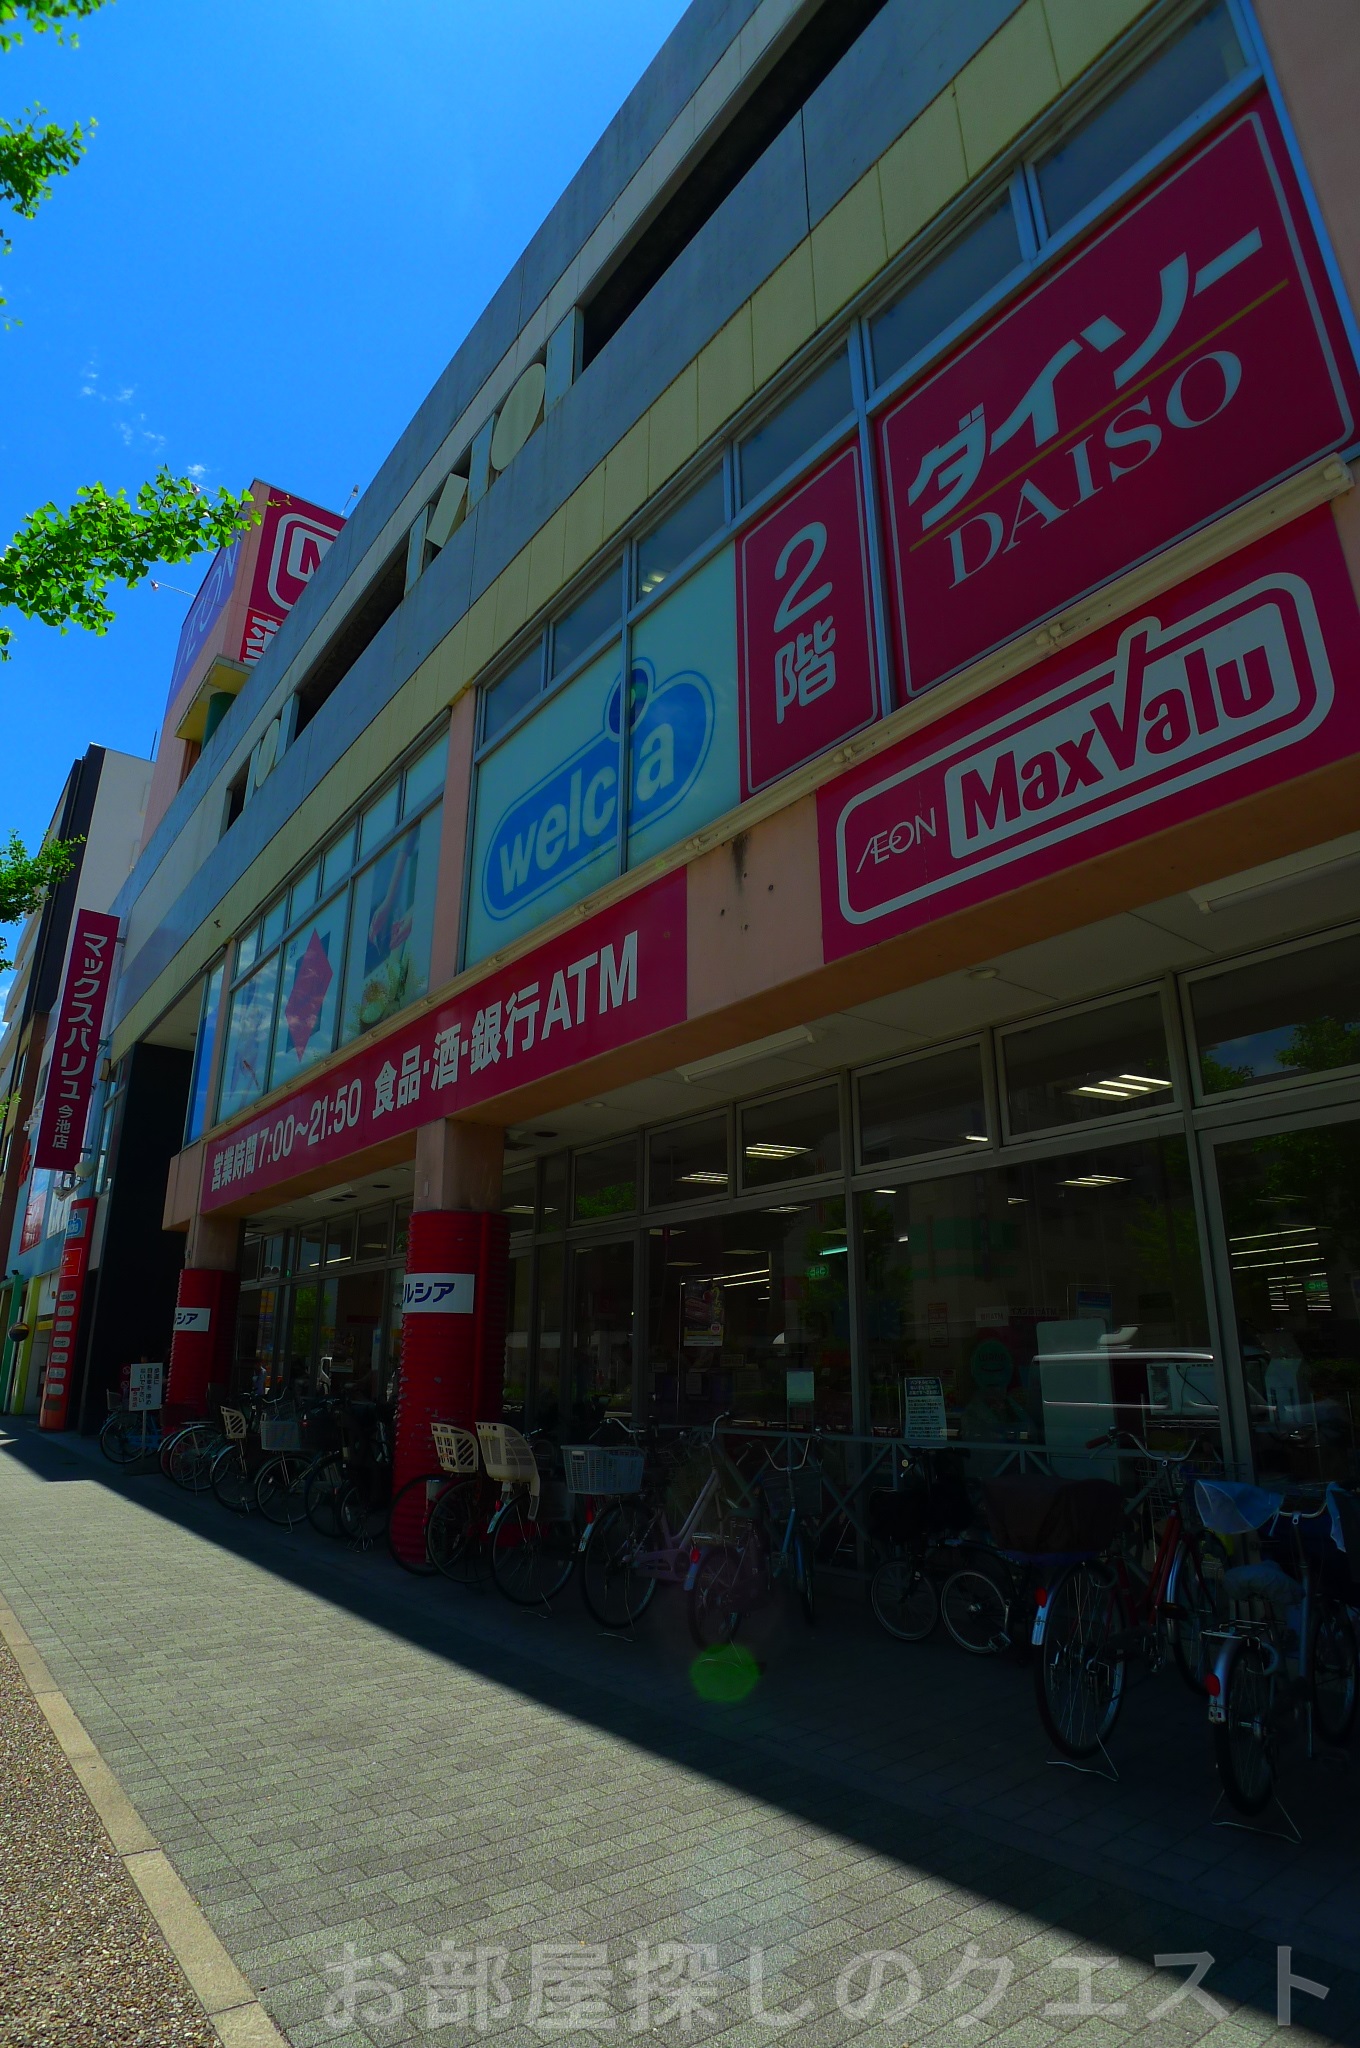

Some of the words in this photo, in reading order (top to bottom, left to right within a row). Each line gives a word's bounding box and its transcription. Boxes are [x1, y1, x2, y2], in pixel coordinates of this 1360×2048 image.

[907, 226, 1263, 532] ダイソー
[943, 349, 1243, 590] DAISO
[774, 521, 836, 725] 2階
[499, 722, 675, 897] welca
[960, 633, 1275, 840] MaxValu
[60, 932, 108, 1100] マックスバリュ
[52, 1104, 74, 1150] 今池店
